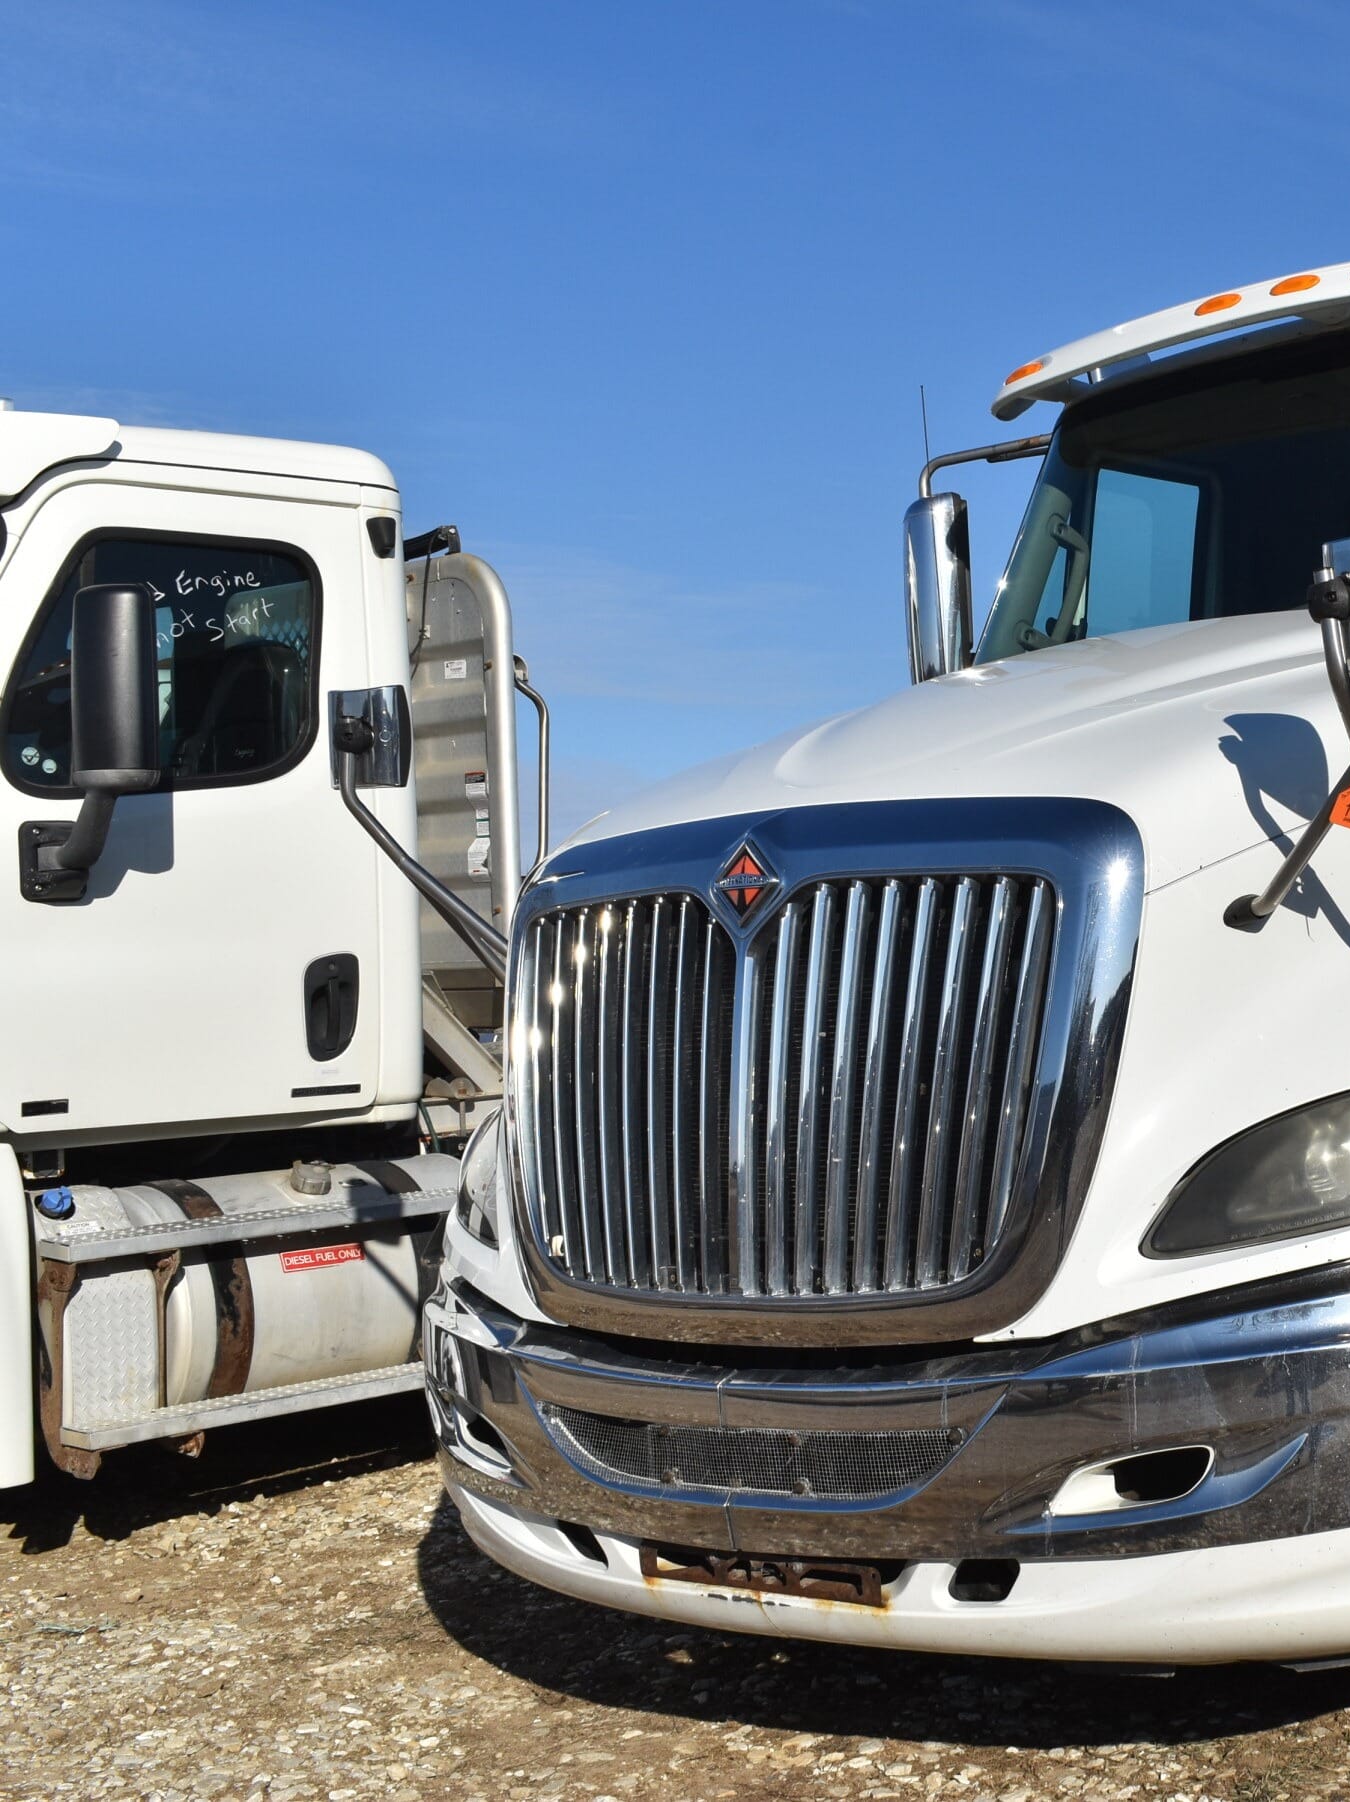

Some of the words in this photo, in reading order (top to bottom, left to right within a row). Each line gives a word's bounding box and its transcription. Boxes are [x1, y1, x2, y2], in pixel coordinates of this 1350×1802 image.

[175, 569, 261, 597] Engine
[284, 1254, 316, 1267] DIESEL
[315, 1251, 339, 1263] FUEL
[338, 1247, 362, 1260] ONLY
